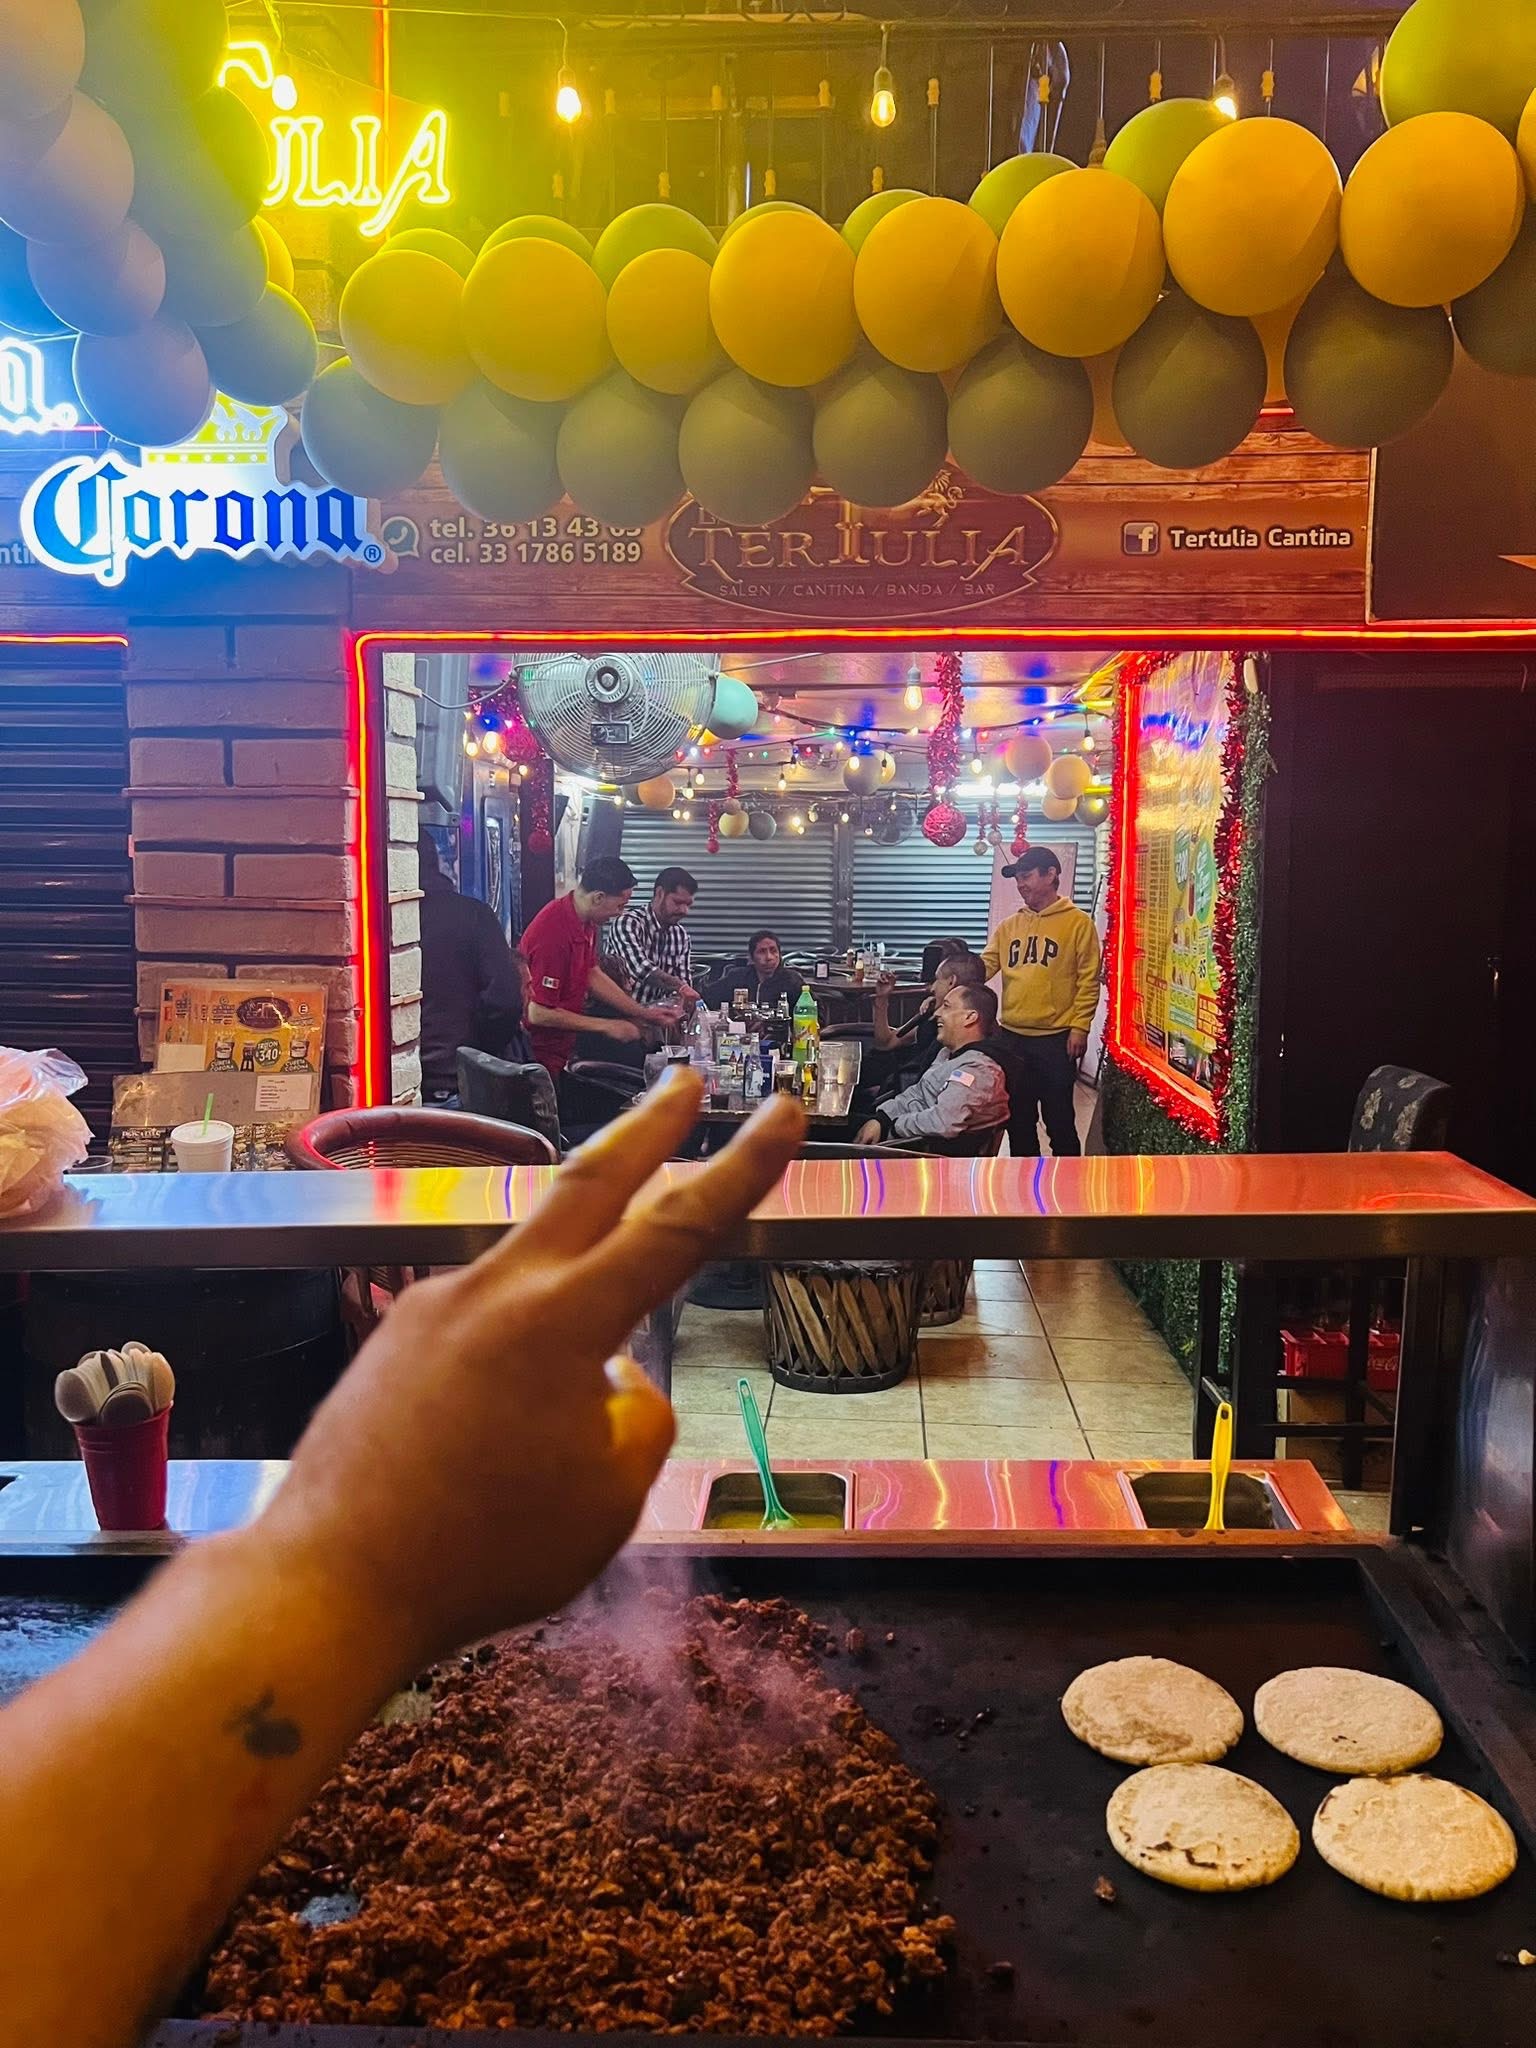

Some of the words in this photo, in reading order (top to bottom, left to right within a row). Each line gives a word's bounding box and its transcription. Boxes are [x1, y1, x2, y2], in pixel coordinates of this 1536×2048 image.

[33, 462, 363, 577] Corona
[430, 517, 474, 537] tel.
[528, 517, 557, 537] 13
[566, 517, 599, 537] 43
[1170, 528, 1259, 548] Tertulia
[1268, 527, 1352, 547] Cantina
[430, 542, 470, 563] cel.
[479, 543, 507, 563] 33
[517, 542, 575, 563] 1786
[582, 541, 641, 562] 5189
[719, 583, 772, 597] SALON
[793, 583, 865, 596] CANTINA
[886, 583, 943, 596] BANDA
[964, 583, 996, 596] BAR
[1007, 935, 1059, 968] GAP
